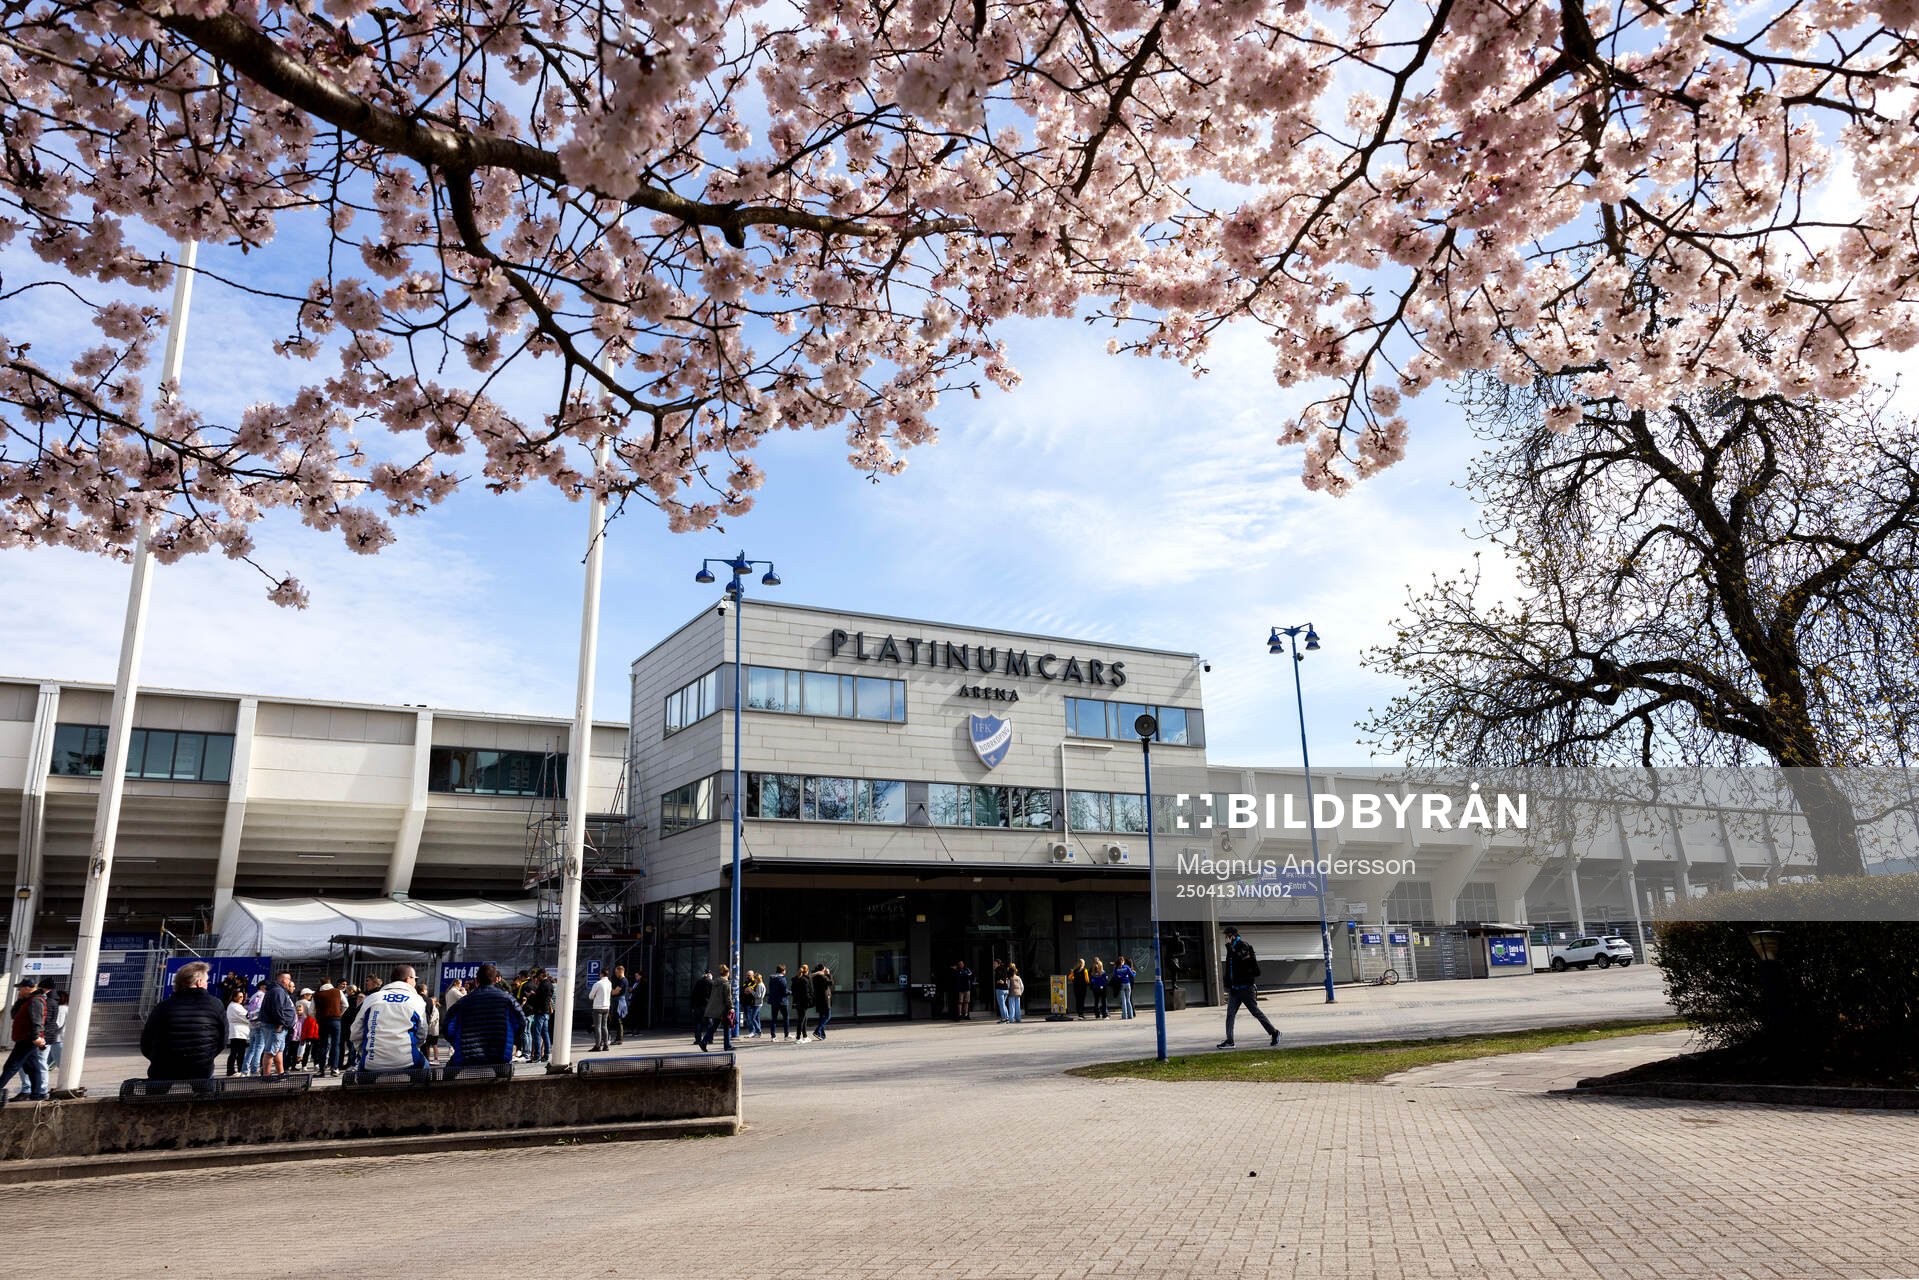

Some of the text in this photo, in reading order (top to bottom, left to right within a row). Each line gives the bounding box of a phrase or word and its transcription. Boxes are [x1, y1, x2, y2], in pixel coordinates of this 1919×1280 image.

[831, 628, 1127, 687] PLATINUMCARS
[960, 684, 1019, 702] ARENA
[975, 722, 992, 733] IFK
[979, 726, 1010, 752] NORRKÖPING
[443, 966, 466, 979] Entré
[382, 993, 410, 1003] 1897
